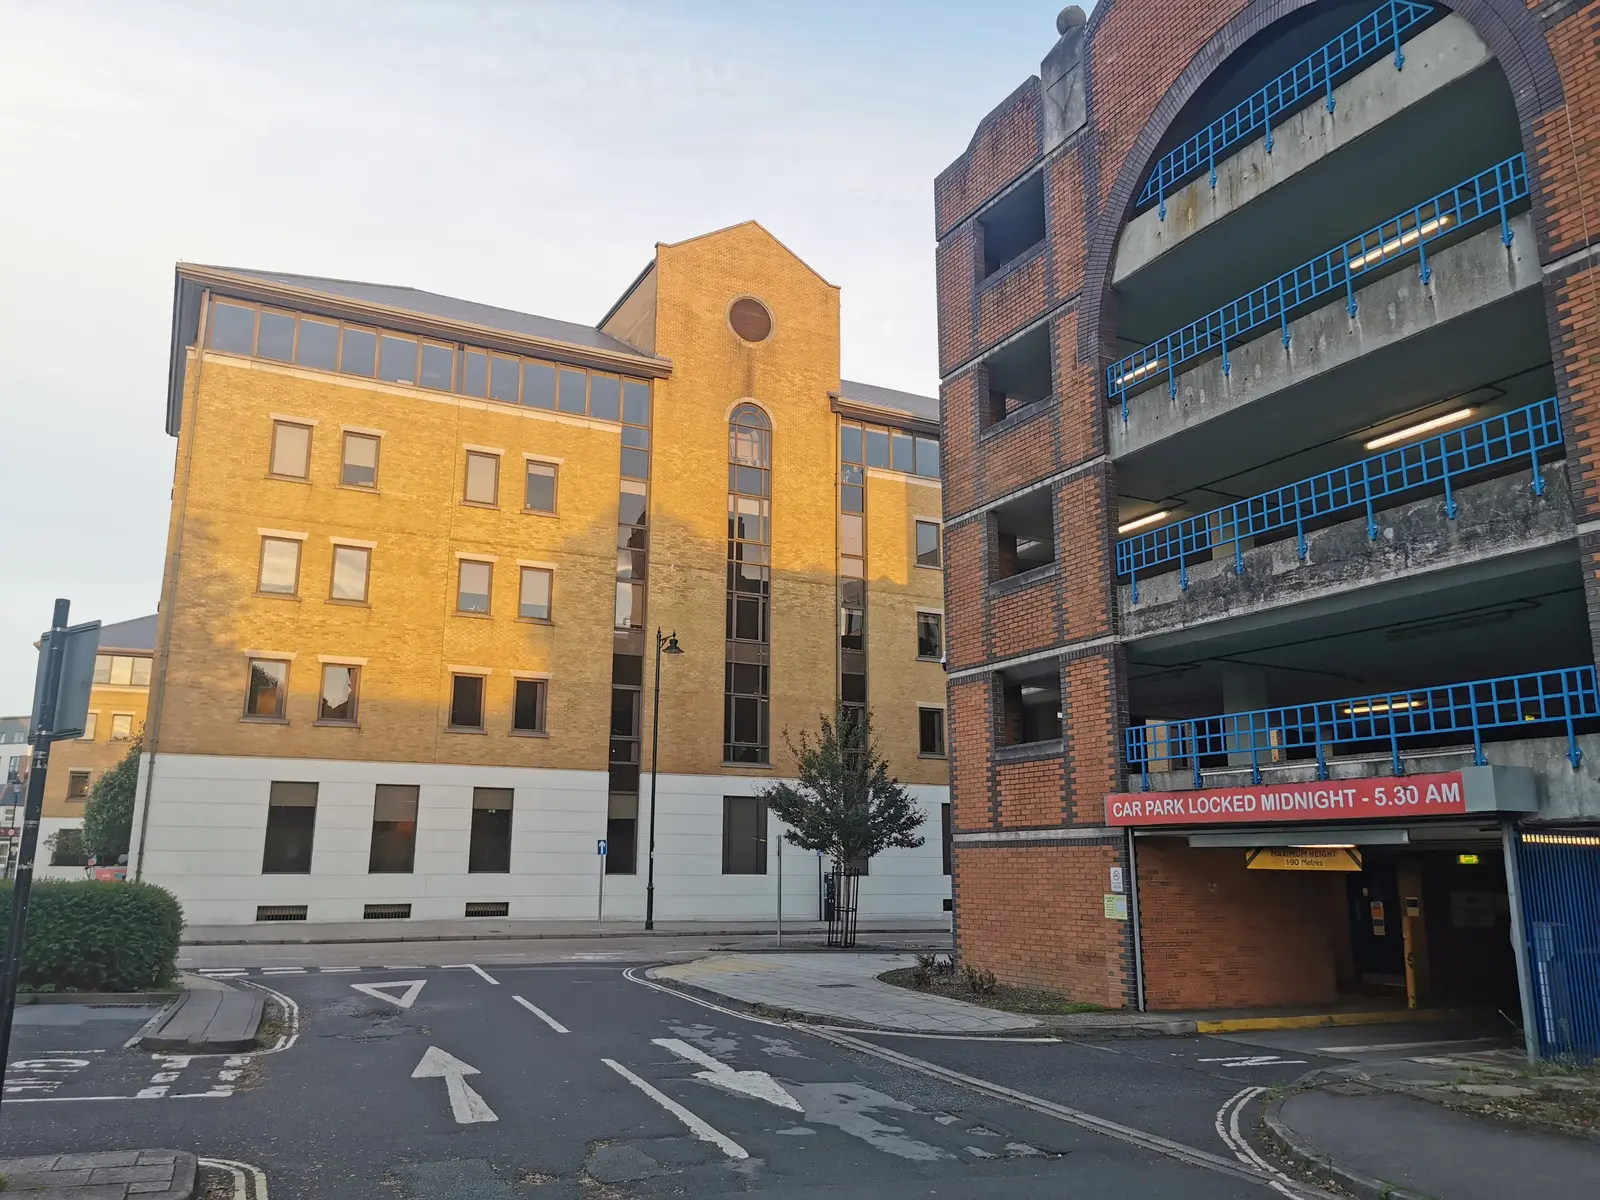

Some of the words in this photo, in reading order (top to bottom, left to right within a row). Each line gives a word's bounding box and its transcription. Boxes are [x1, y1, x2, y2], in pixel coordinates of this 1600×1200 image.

[1113, 801, 1142, 818] CAR
[1145, 798, 1186, 816] PARK
[1188, 794, 1257, 814] LOCKED
[1261, 788, 1356, 811] MIDNIGHT
[1374, 785, 1419, 806] 5.30
[1425, 782, 1460, 804] AM
[1301, 858, 1324, 866] Metres
